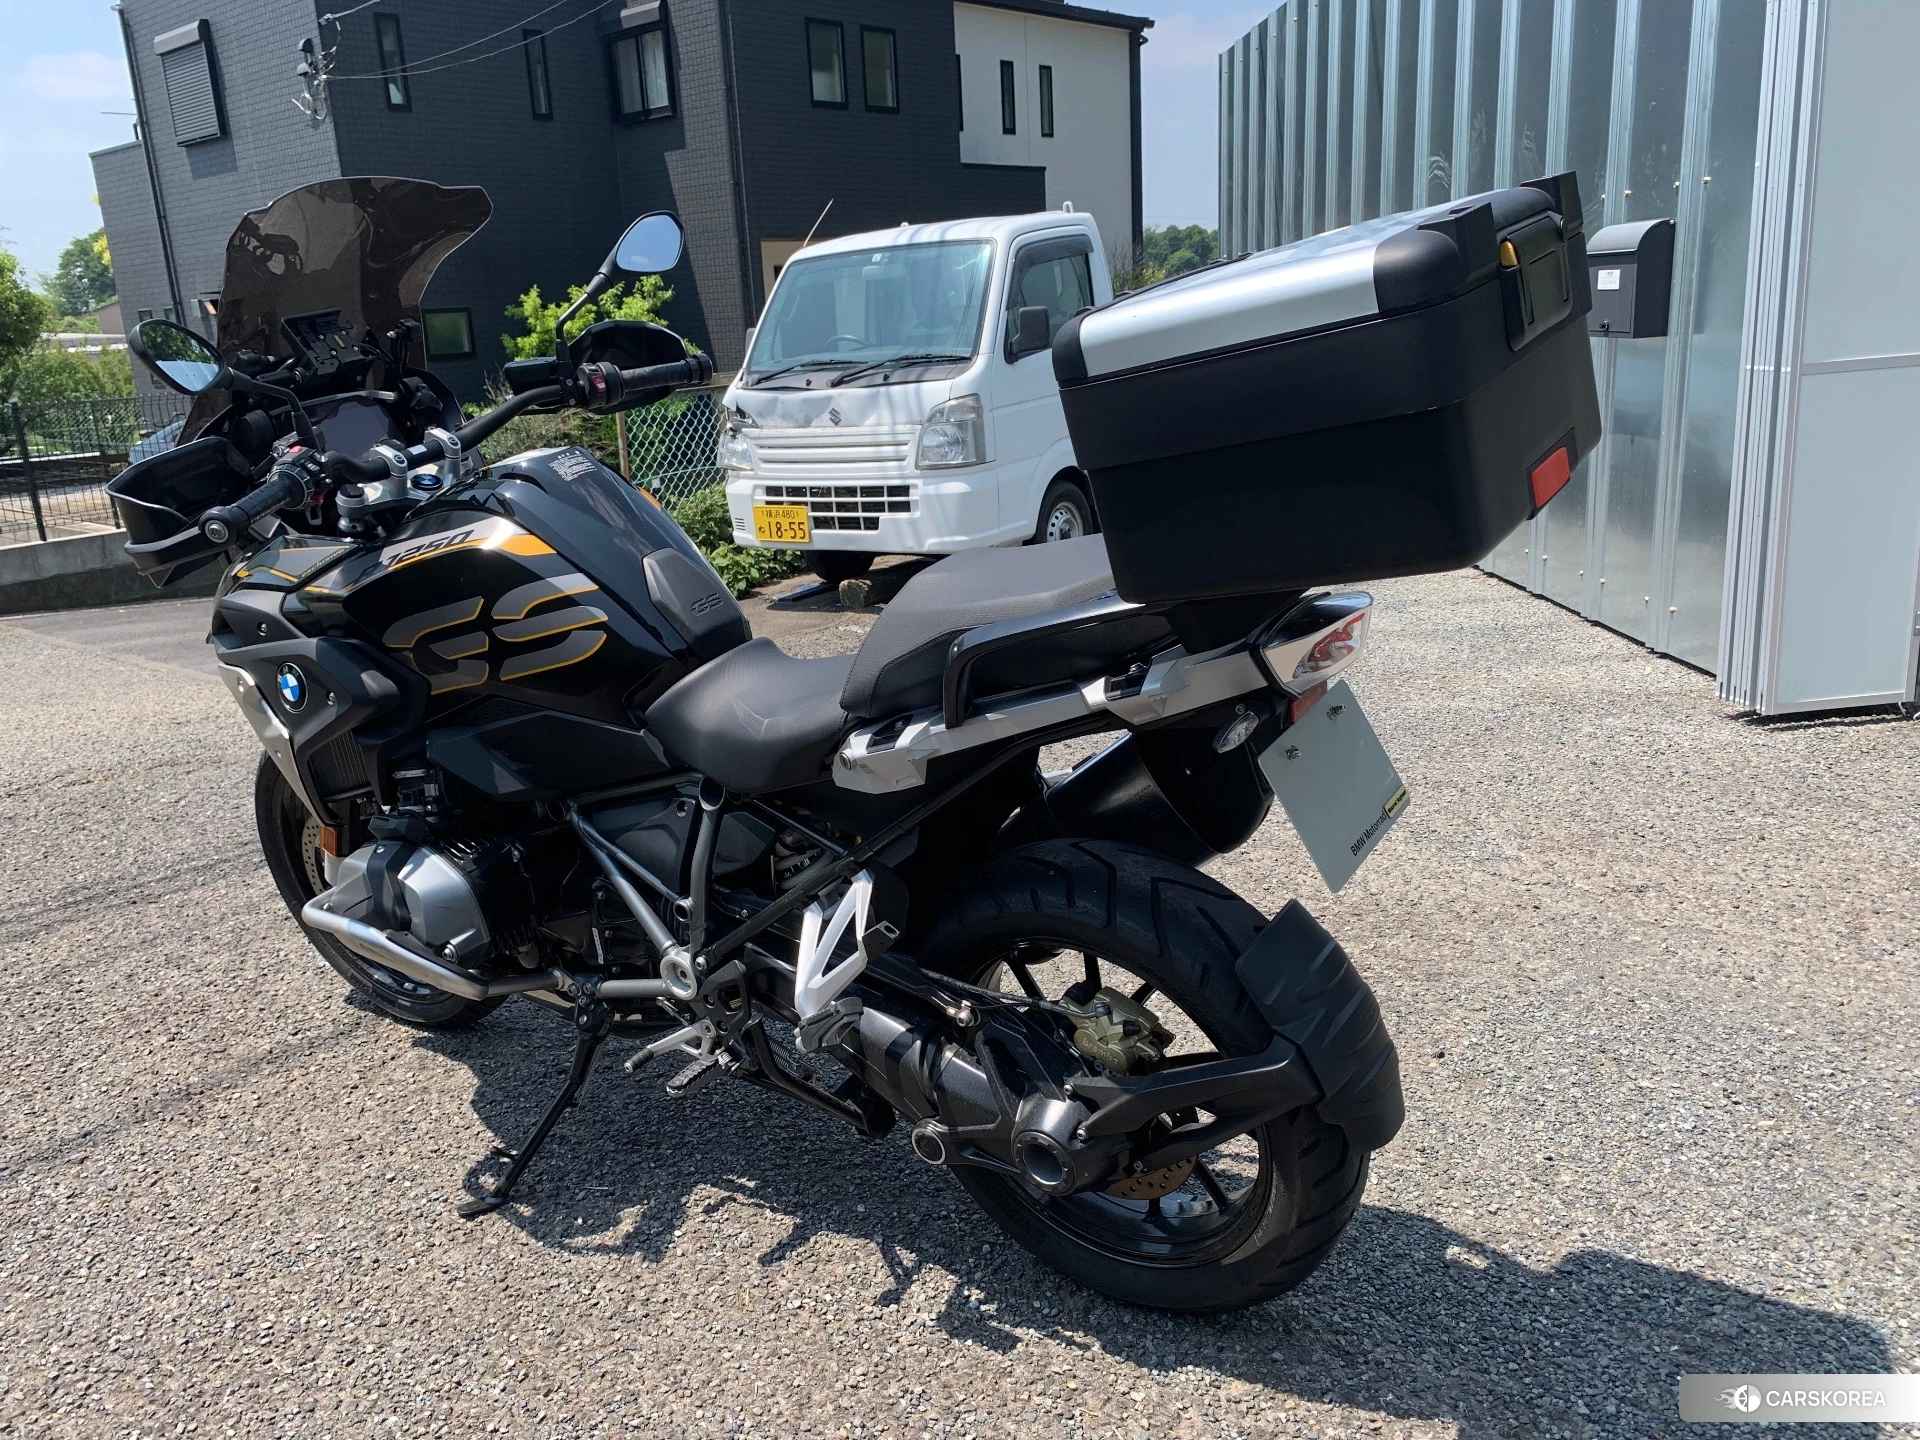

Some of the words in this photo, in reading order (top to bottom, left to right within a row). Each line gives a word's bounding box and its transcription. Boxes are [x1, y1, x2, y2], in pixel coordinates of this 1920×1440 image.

[782, 509, 795, 519] 480
[768, 521, 806, 539] 18-55
[301, 548, 345, 578] exclusive
[386, 529, 475, 567] 1250
[690, 592, 723, 617] GS
[381, 572, 609, 696] GS
[1350, 836, 1367, 857] BMW
[1363, 810, 1388, 841] Motorrad
